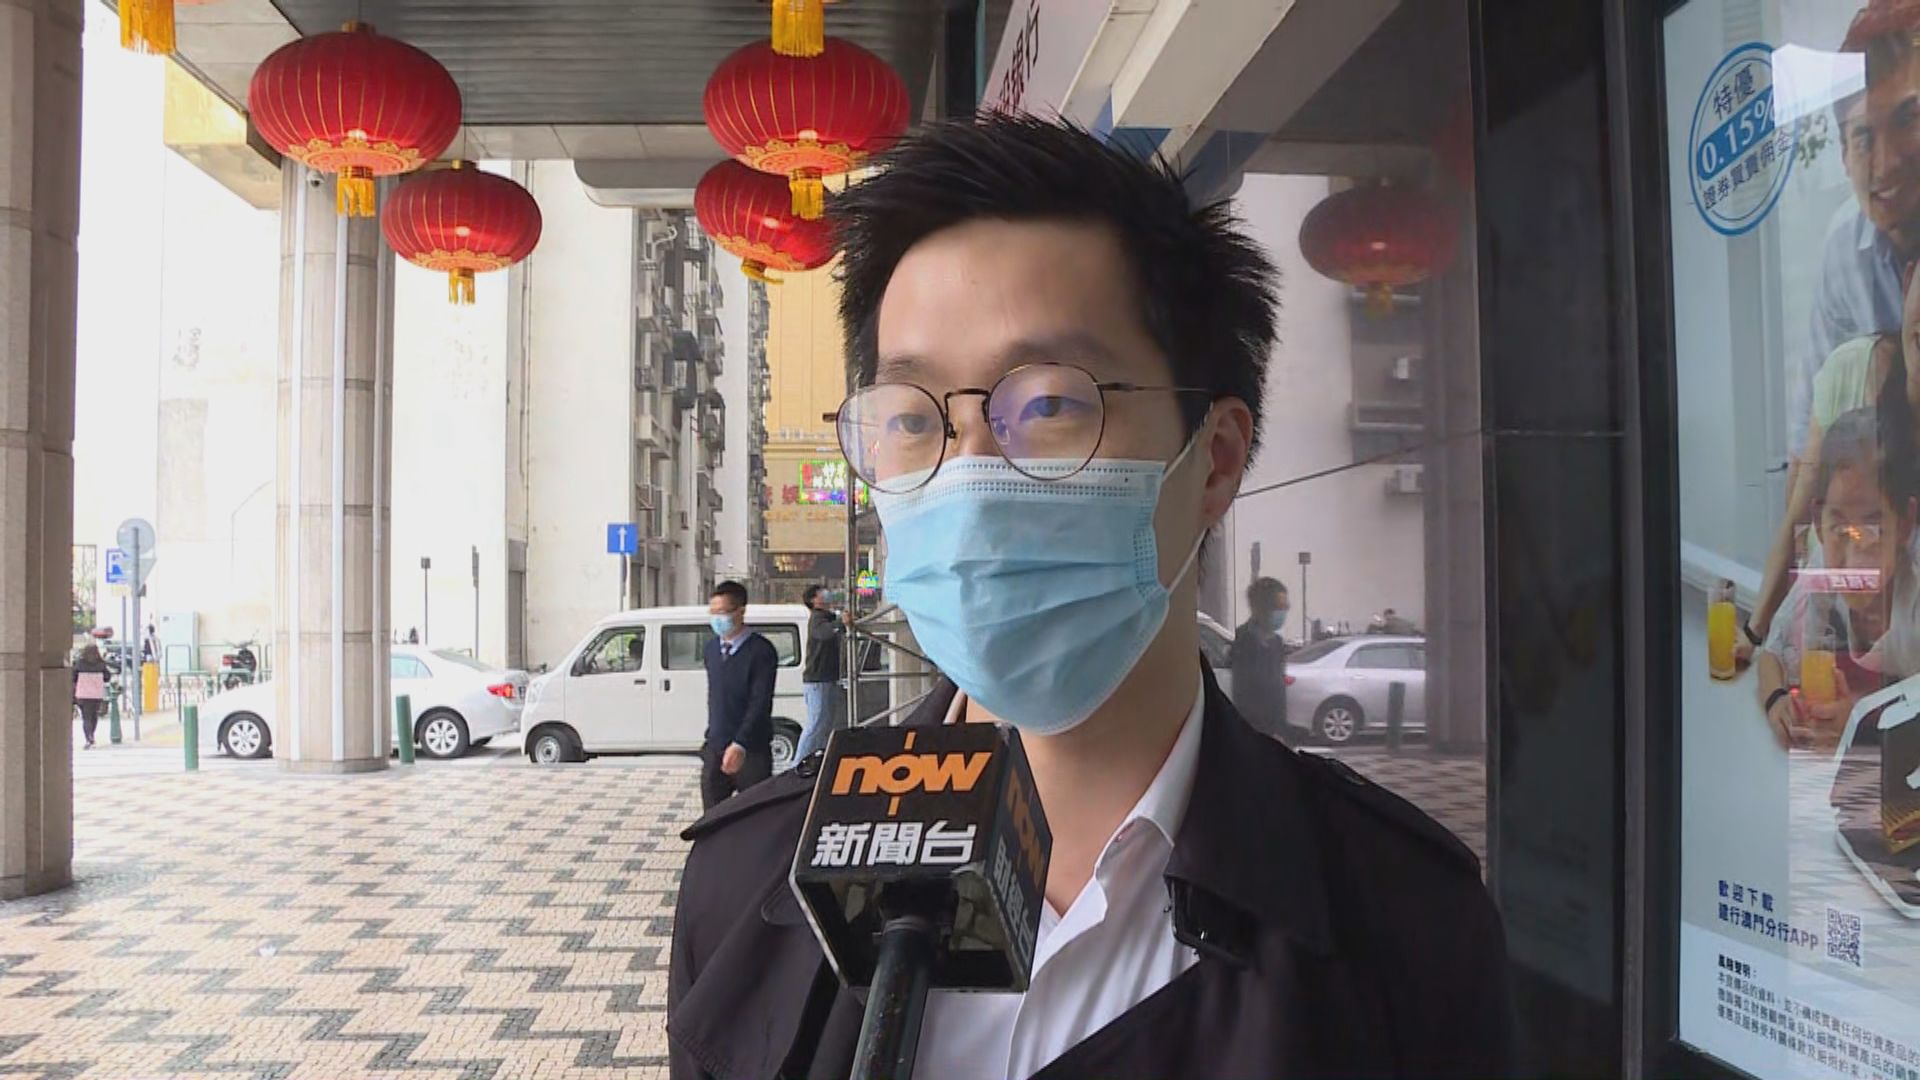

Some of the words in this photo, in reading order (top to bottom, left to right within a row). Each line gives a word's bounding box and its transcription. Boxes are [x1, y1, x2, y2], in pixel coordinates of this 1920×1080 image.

[1713, 64, 1756, 121] 特優
[831, 750, 992, 797] now
[811, 820, 977, 867] 新聞台
